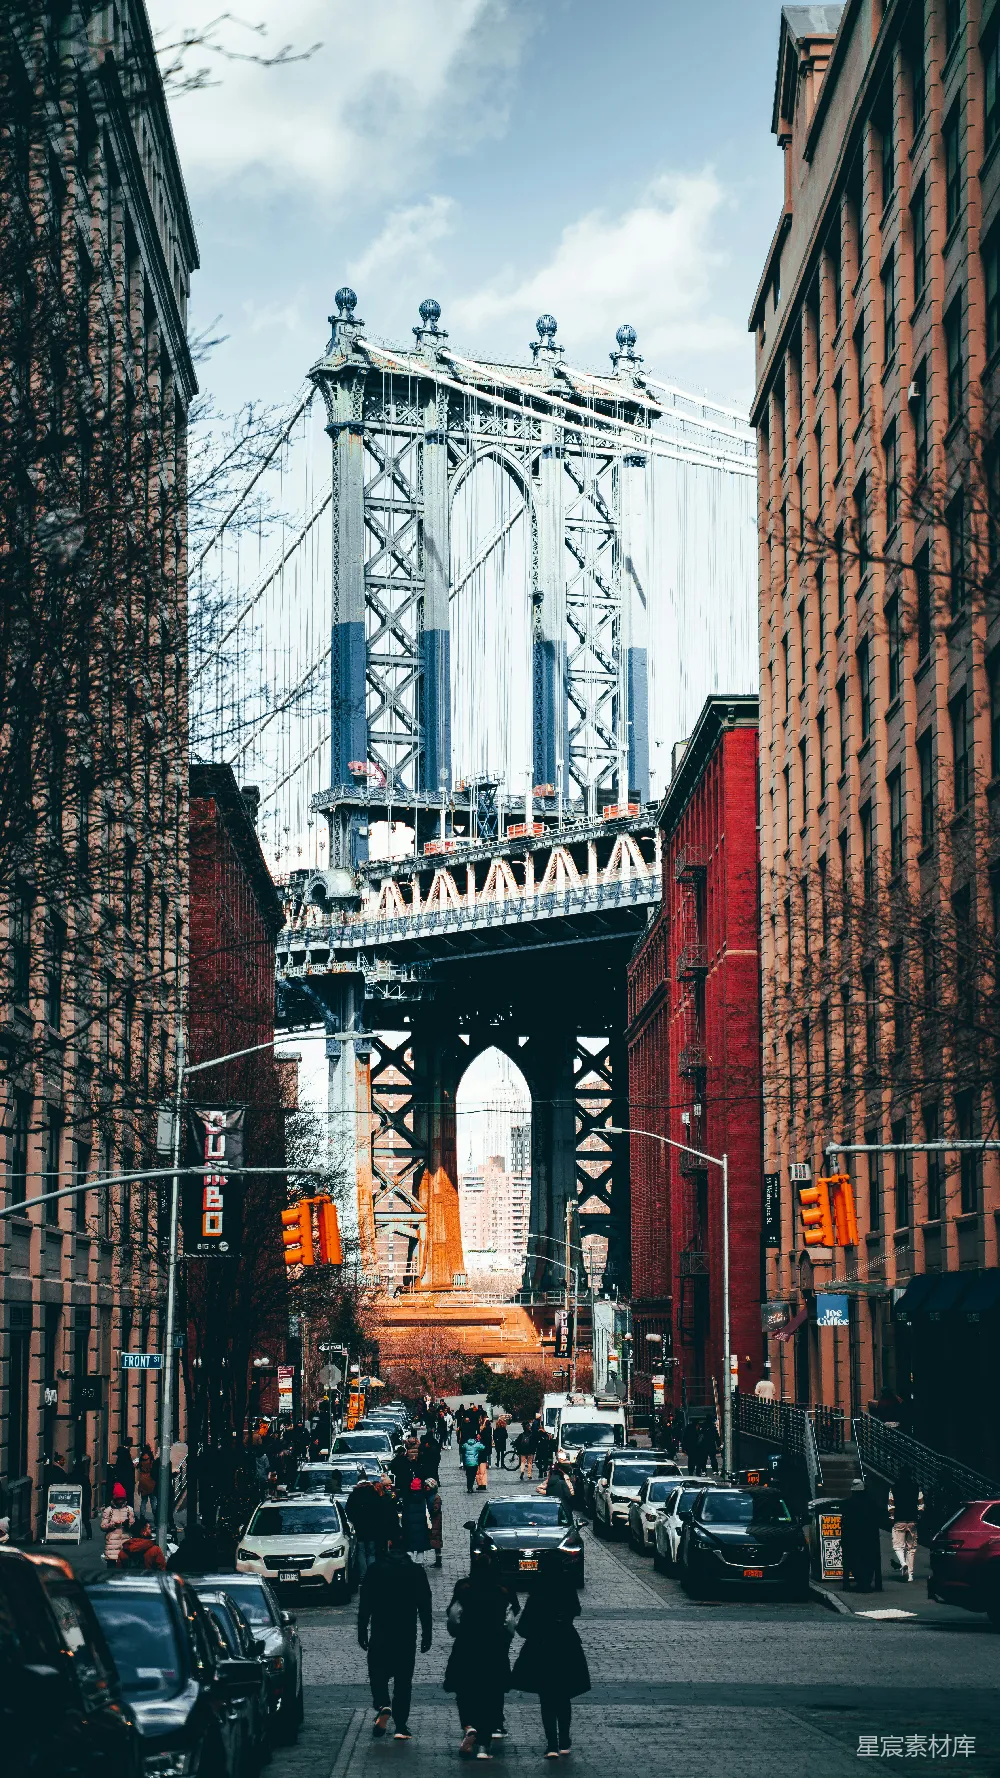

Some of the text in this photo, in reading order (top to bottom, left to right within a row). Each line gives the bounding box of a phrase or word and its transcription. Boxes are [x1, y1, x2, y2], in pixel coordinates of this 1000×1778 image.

[824, 1309, 842, 1319] Joe
[817, 1316, 849, 1326] Coffee
[560, 1311, 569, 1351] DUMBO
[124, 1355, 150, 1368] FRONT
[772, 1461, 777, 1469] P
